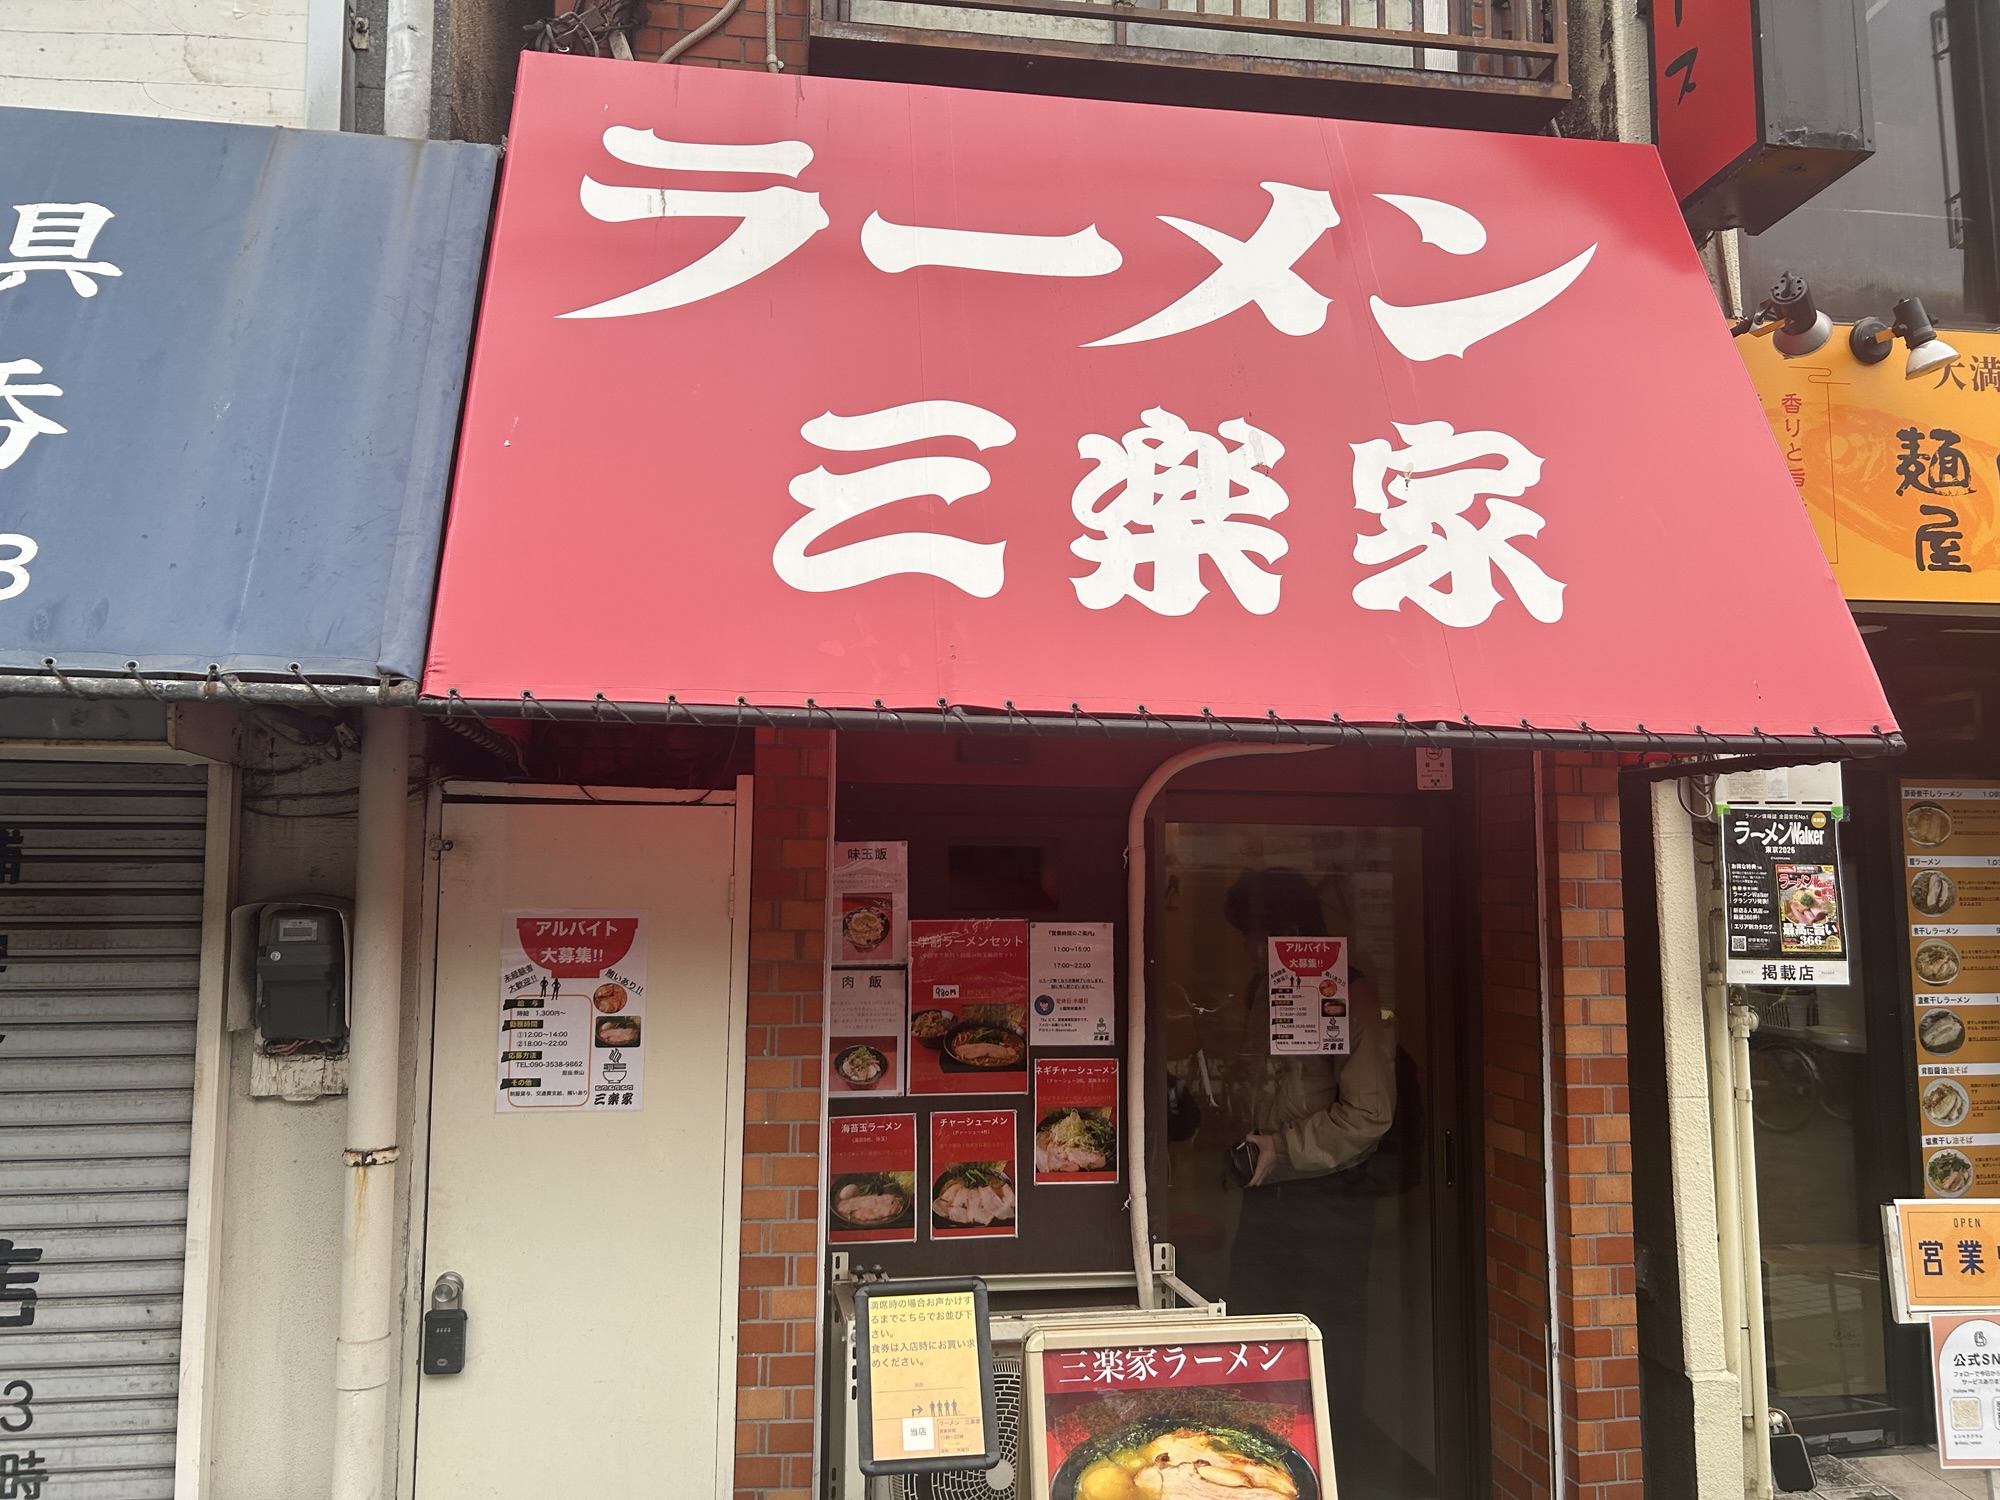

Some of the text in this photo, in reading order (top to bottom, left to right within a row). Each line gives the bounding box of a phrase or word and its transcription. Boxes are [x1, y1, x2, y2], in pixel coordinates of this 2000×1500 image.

[555, 125, 1598, 362] ラーメン
[772, 400, 1568, 628] 三楽家
[1733, 820, 1825, 846] ラーメンWalker
[846, 847, 888, 860] 味玉飯
[535, 921, 618, 937] アルバイト
[1782, 922, 1838, 936] 最高に旨い
[541, 947, 603, 963] 大募集!!
[1285, 943, 1331, 953] アルバイト
[1761, 964, 1815, 982] 掲載店
[1036, 1065, 1118, 1076] ネギチャーシューメン
[841, 1121, 903, 1134] 海苔玉ラーメン
[939, 1116, 1009, 1128] チャーシューメン
[1952, 1216, 1982, 1229] OPEN
[1917, 1239, 2000, 1276] 営業
[870, 1296, 973, 1311] 満席時の場合お声かけす
[870, 1310, 973, 1325] るまでこちらでお並び下
[871, 1329, 894, 1339] さい。
[871, 1338, 976, 1354] 食券は入店時にお買い求
[871, 1358, 925, 1369] めください。
[1058, 1343, 1287, 1384] 三楽家ラーメン
[909, 1426, 927, 1437] 当店
